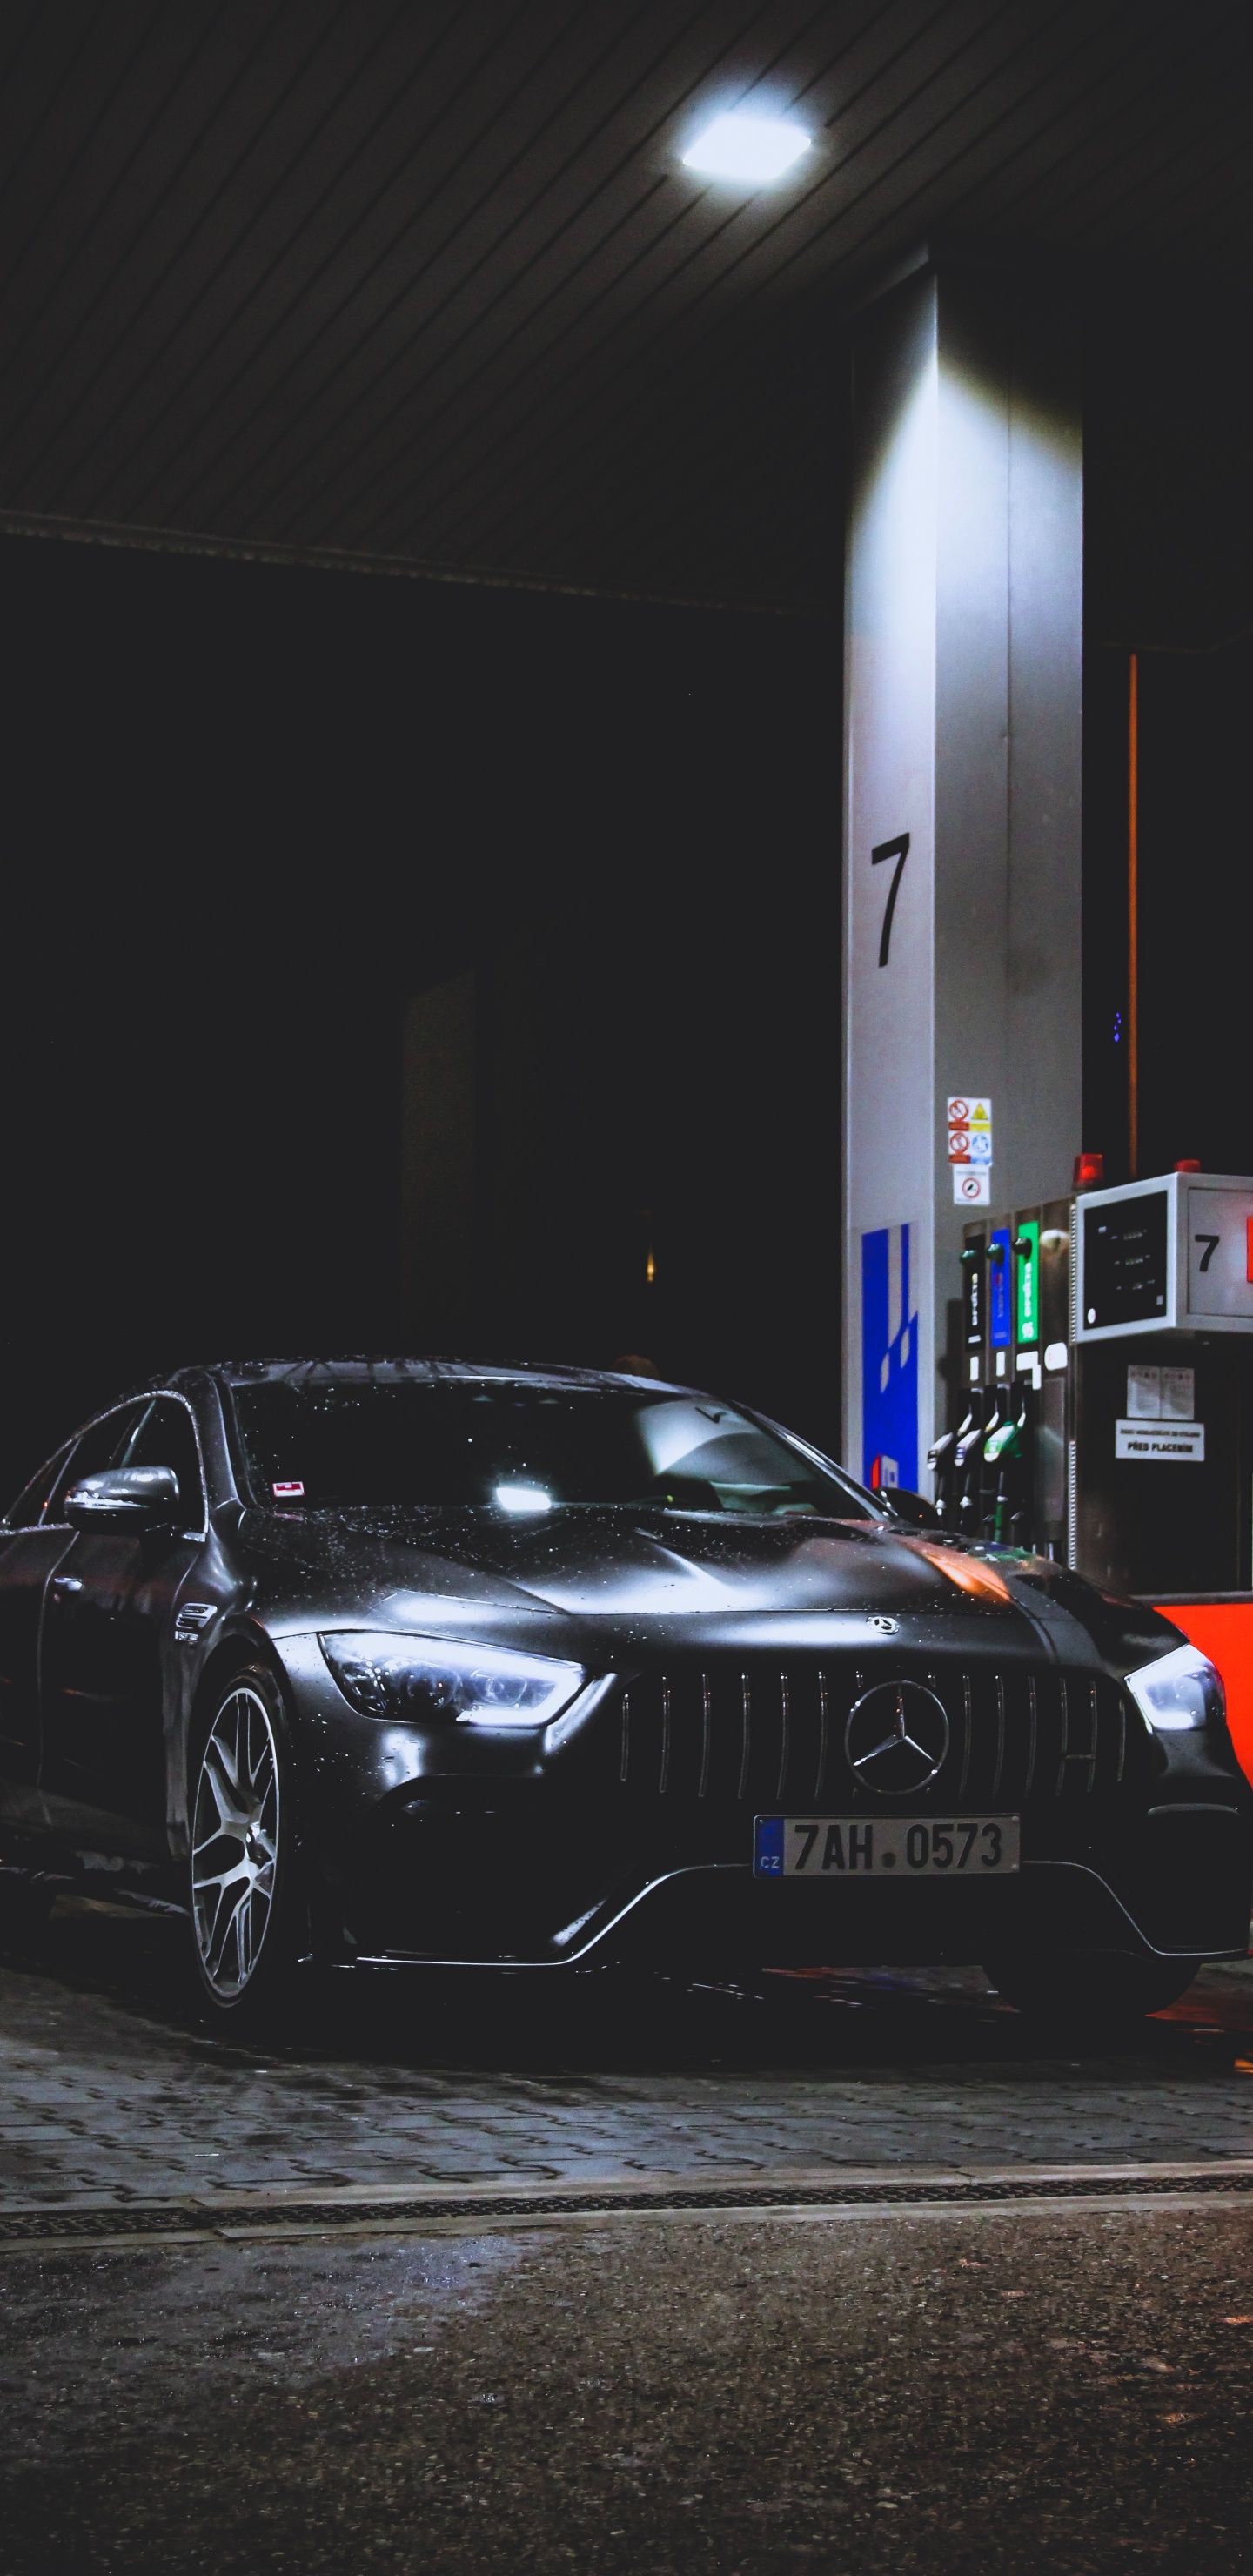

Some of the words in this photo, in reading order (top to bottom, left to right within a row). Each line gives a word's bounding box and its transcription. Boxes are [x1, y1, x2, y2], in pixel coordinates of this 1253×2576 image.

[872, 832, 910, 968] 7
[1194, 1234, 1220, 1272] 7
[760, 1856, 780, 1869] CZ
